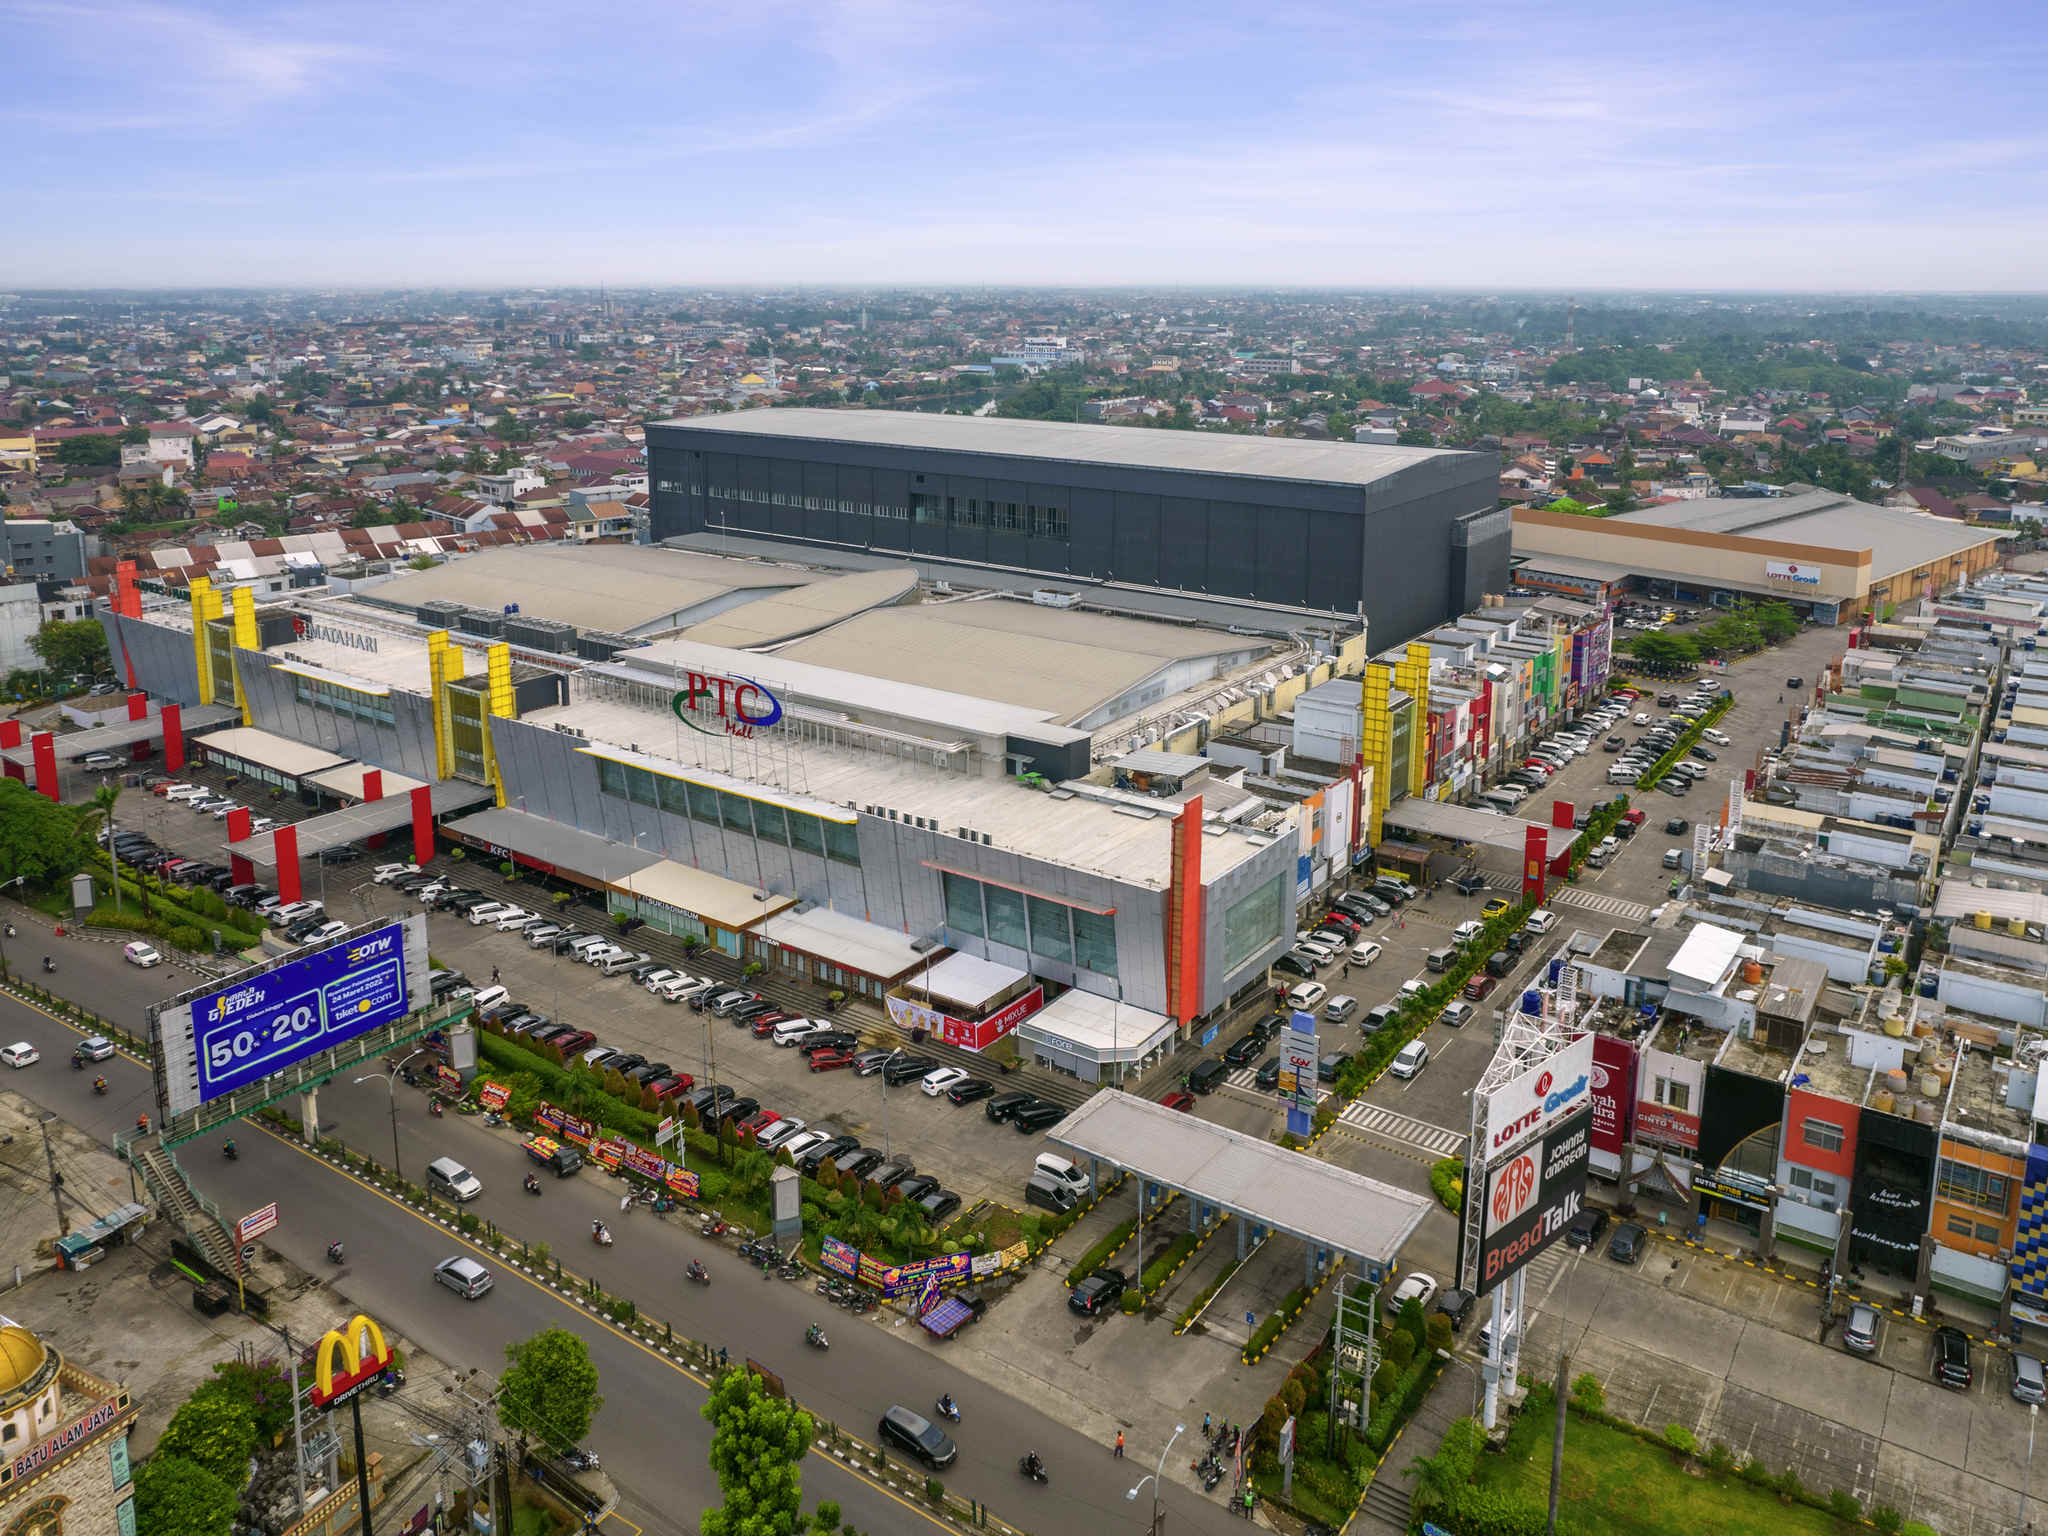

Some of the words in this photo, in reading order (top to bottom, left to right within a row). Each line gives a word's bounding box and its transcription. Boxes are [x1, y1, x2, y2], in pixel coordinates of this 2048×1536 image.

[307, 622, 378, 653] MATAHARI
[686, 671, 759, 723] PTC
[725, 719, 753, 740] Mall
[490, 844, 508, 858] KFC
[359, 935, 392, 957] OTW
[1004, 1003, 1028, 1025] MIXUE
[1290, 1055, 1312, 1067] CGV
[1493, 1105, 1542, 1149] LOTTE
[1485, 1189, 1582, 1281] BreadTalk
[15, 1446, 49, 1477] BATU
[51, 1422, 84, 1455] ALAM
[87, 1404, 116, 1432] JAYA
